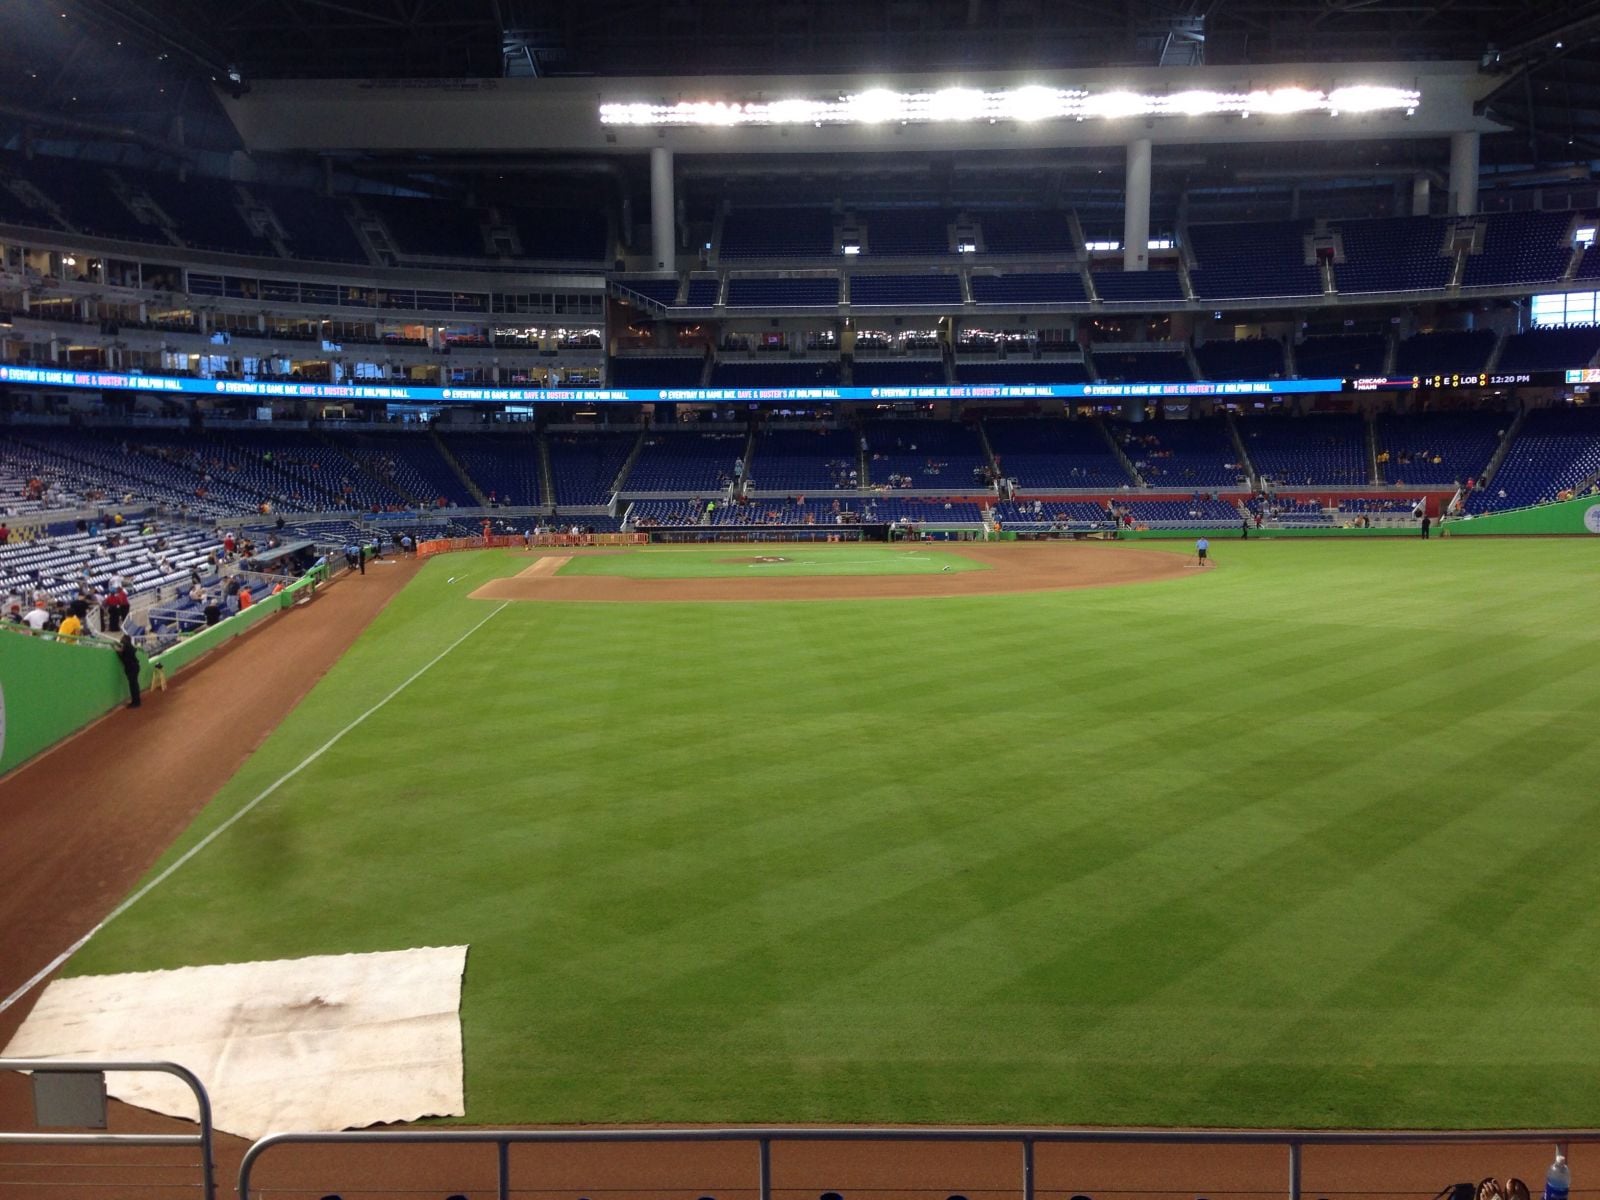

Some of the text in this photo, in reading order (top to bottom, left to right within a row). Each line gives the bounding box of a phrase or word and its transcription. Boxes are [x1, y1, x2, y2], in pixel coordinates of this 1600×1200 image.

[75, 374, 90, 385] DAVE
[300, 386, 315, 395] DAVE
[738, 390, 752, 398] DAVE
[950, 388, 964, 396] DAVE
[1164, 385, 1178, 394] DAVE
[524, 390, 538, 399] DAVE
